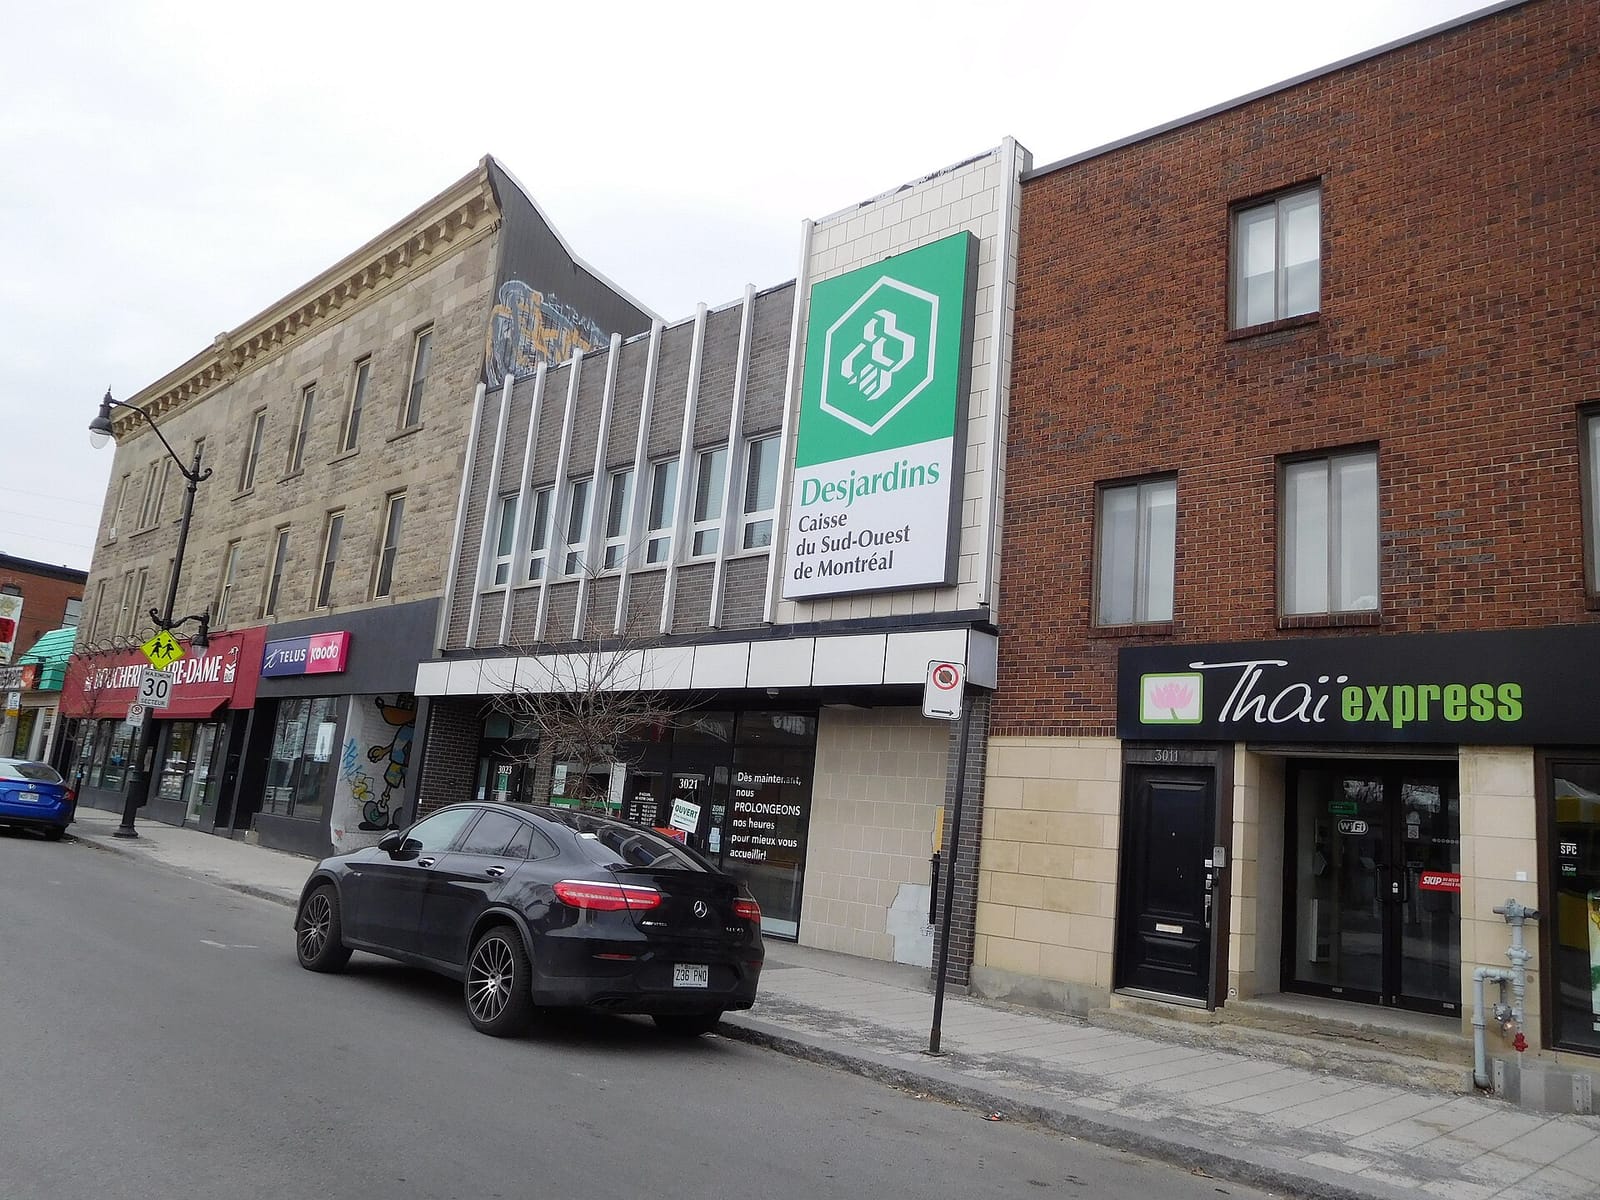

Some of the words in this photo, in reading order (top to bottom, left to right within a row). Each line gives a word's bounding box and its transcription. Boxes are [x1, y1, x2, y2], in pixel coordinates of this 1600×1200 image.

[800, 459, 940, 508] Desjardins
[798, 513, 848, 533] Caisse
[796, 538, 816, 557] du
[820, 525, 910, 553] Sud-Ouest
[793, 561, 813, 580] de
[817, 550, 894, 577] Montréal
[279, 648, 307, 663] TELUS
[94, 663, 148, 689] BOUCHERI
[143, 678, 168, 698] 30
[1189, 659, 1349, 724] Thaï
[1341, 682, 1523, 729] express
[1154, 749, 1179, 762] 3011
[498, 765, 513, 775] 3023
[737, 772, 753, 782] Dès
[678, 778, 698, 790] 3021
[735, 789, 755, 797] nous
[675, 804, 698, 819] OUVERT
[734, 802, 801, 816] PROLONGEONS
[733, 819, 747, 827] nos
[748, 817, 775, 830] heures
[1341, 821, 1366, 833] WiFi
[731, 834, 750, 844] pour
[751, 834, 776, 846] mieux
[777, 838, 797, 847] vous
[729, 848, 767, 860] accueillir!
[1560, 845, 1577, 855] SPC
[1422, 876, 1442, 886] SKIP
[675, 968, 690, 981] Z36
